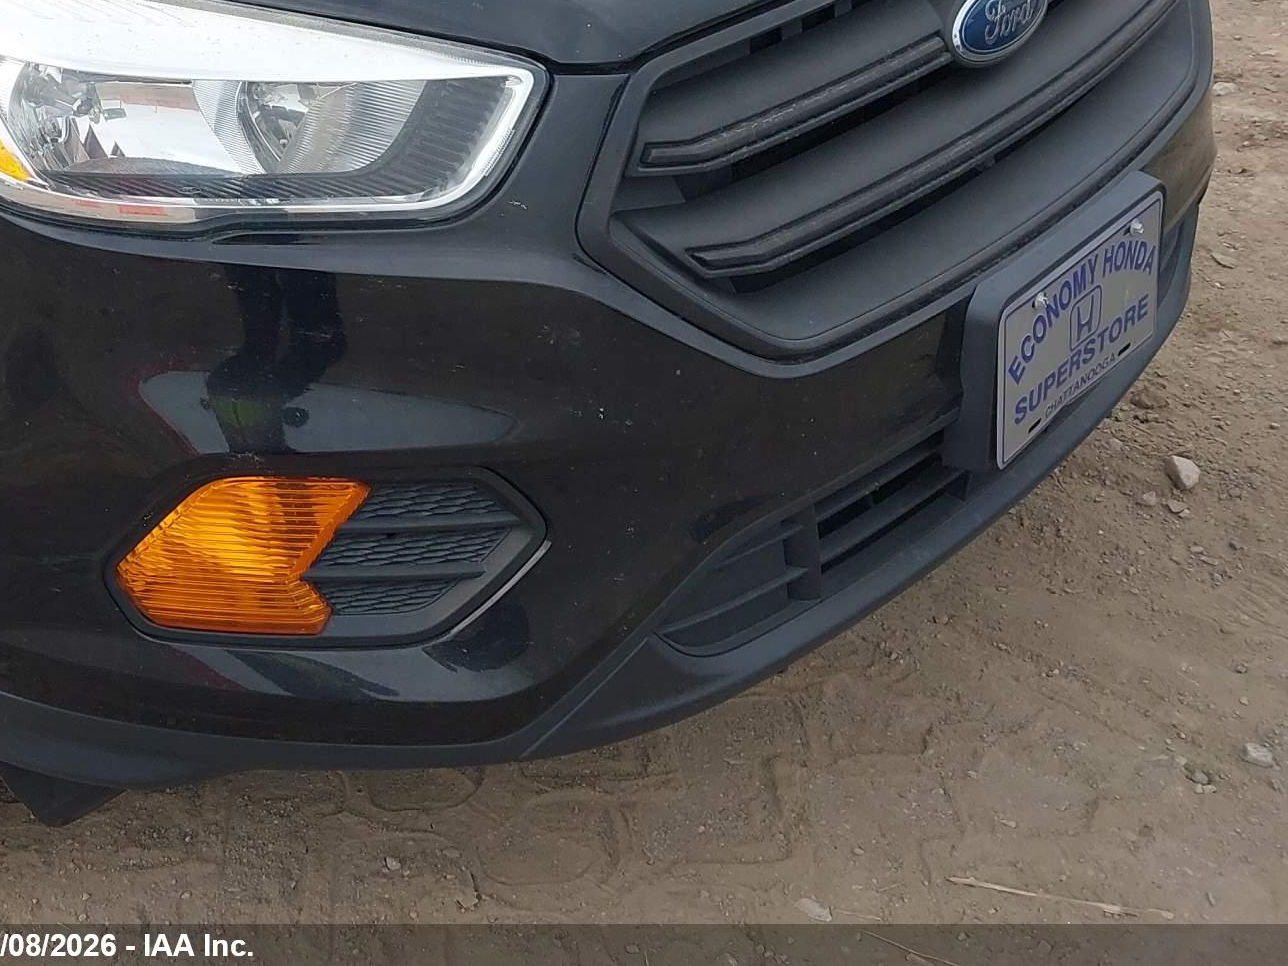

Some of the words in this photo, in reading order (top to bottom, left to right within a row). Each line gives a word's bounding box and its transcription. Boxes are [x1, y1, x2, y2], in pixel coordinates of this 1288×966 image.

[1007, 253, 1099, 386] ECONOMY
[1101, 239, 1157, 278] HONDA
[1013, 293, 1150, 426] SUPERSTORE
[1044, 351, 1117, 419] CHATTANOOGA
